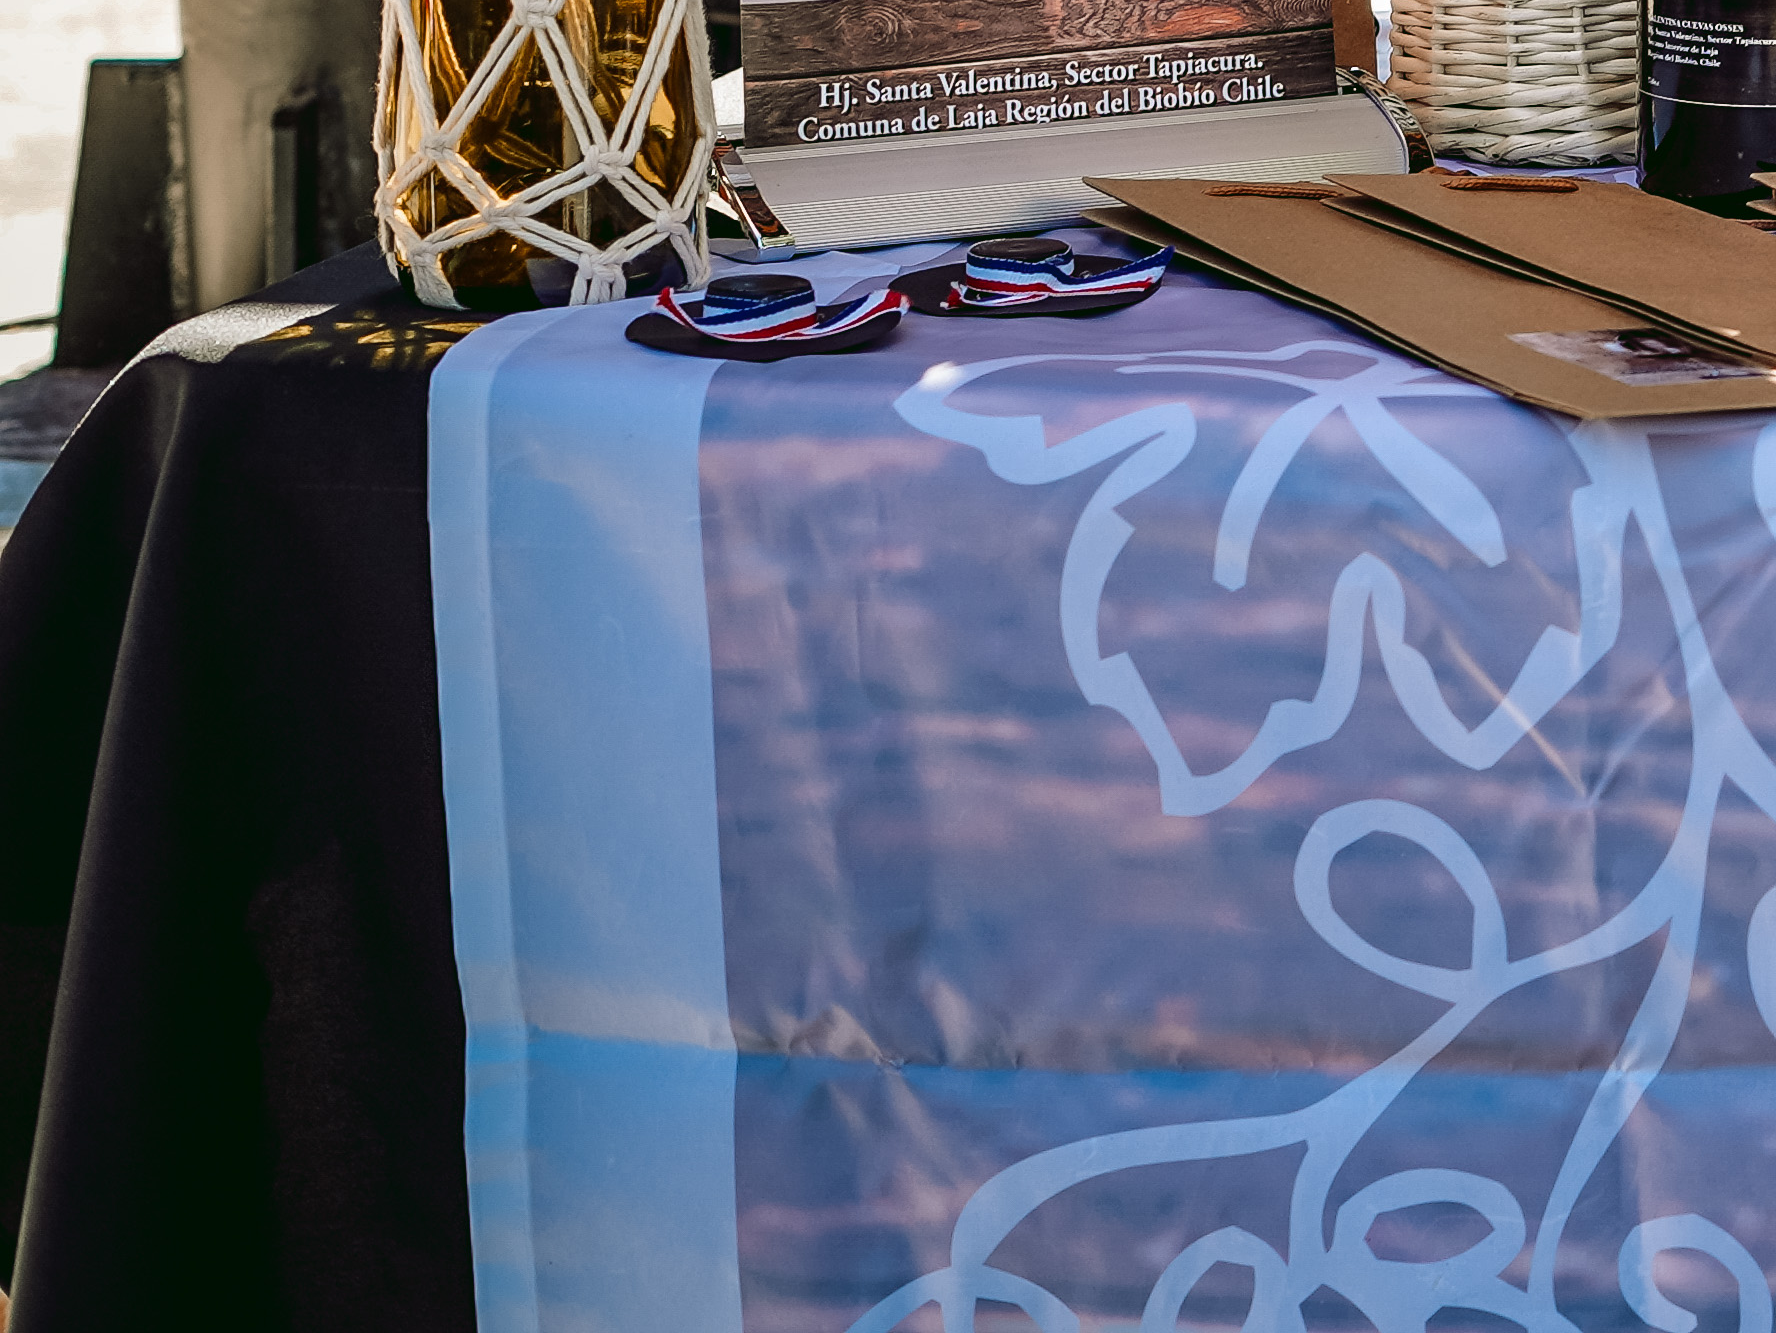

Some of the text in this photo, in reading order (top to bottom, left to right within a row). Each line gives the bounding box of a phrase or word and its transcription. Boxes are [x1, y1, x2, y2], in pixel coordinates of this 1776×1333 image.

[798, 75, 1285, 141] Comuna de Laja Región del Biobío Chile
[819, 52, 1264, 114] Hj. Santa Valentina, Sector Tapiacura.
